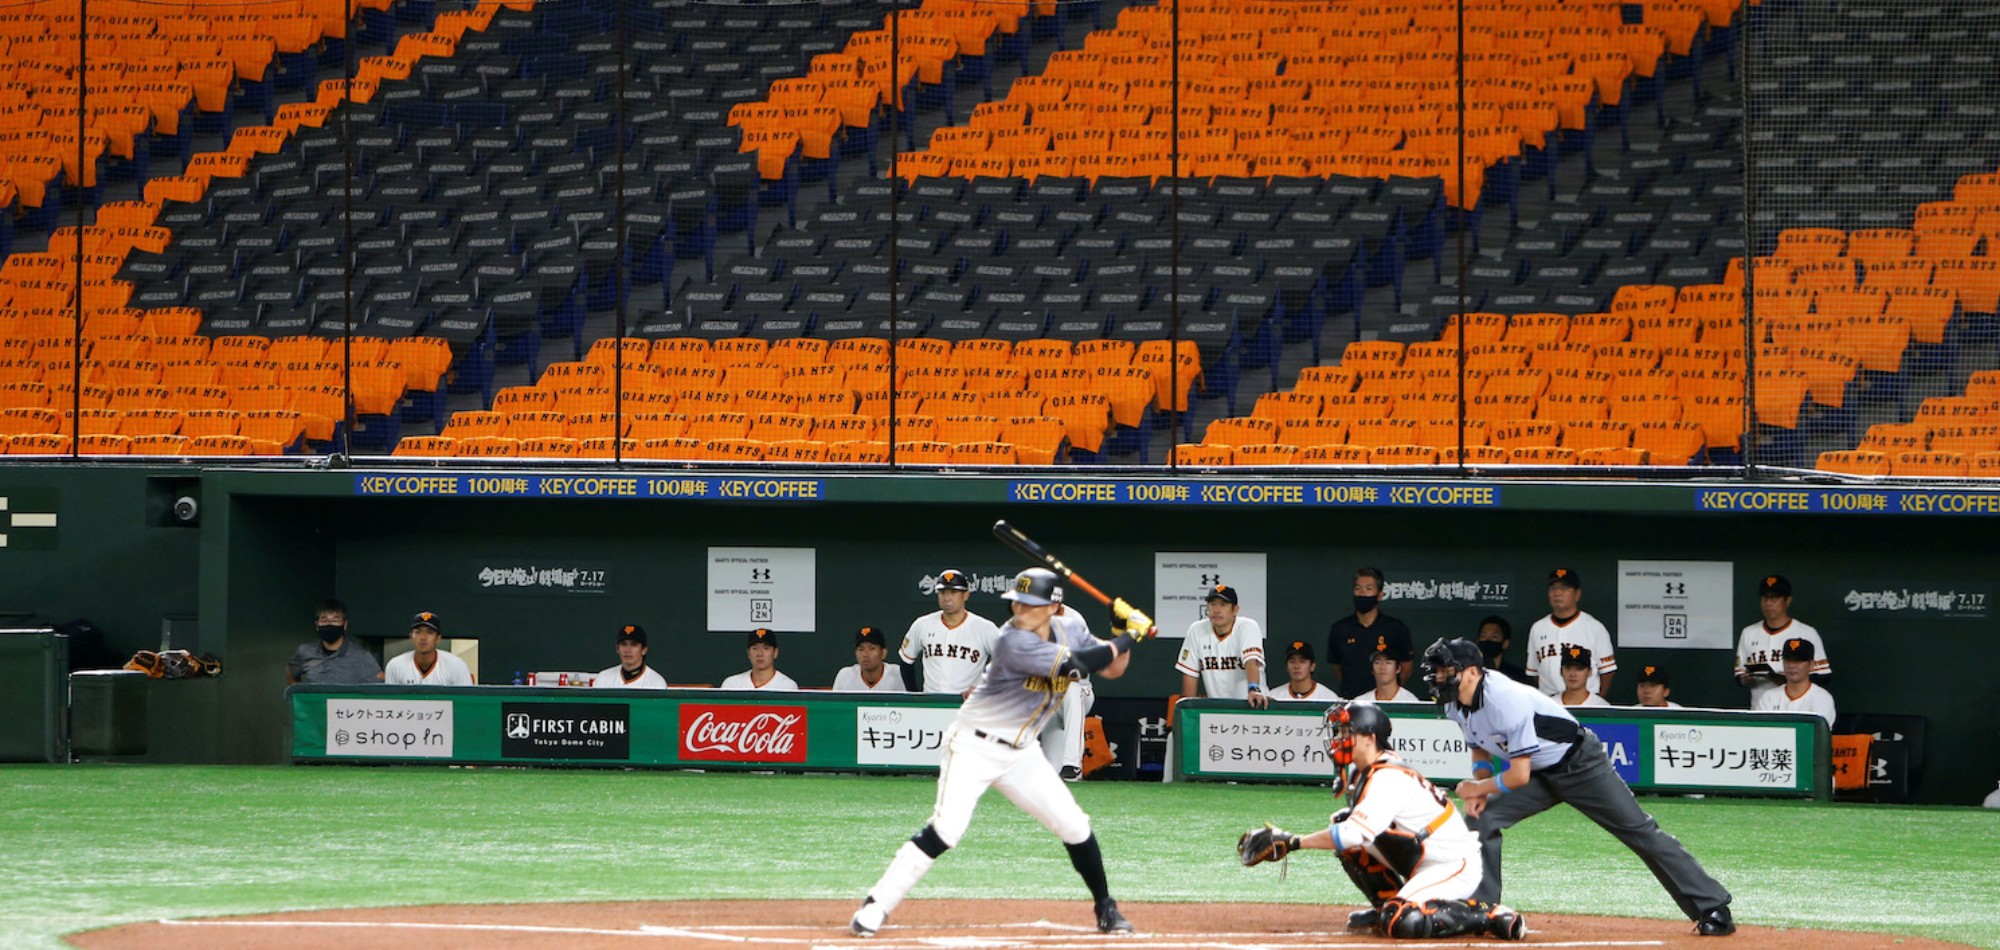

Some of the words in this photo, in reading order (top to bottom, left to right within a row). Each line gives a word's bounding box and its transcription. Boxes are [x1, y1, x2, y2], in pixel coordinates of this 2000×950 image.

[409, 33, 452, 45] GIANTS
[280, 108, 329, 120] GIANTS
[733, 109, 779, 118] GIANTS
[974, 105, 1019, 117] GIANTS
[236, 127, 282, 139] GIANTS
[748, 131, 794, 142] GIANTS
[935, 130, 984, 142] GIANTS
[997, 127, 1047, 138] GIANTS
[194, 156, 242, 166] GIANTS
[956, 158, 1003, 170] GIANTS
[1019, 156, 1067, 168] GIANTS
[1680, 291, 1734, 302] GIANTS
[1511, 318, 1563, 327] GIANTS
[1639, 318, 1692, 329] GIANTS
[155, 336, 211, 346] GIANTS
[222, 338, 269, 350] GIANTS
[654, 341, 704, 351] GIANTS
[1074, 340, 1126, 356] GIANTS
[1410, 348, 1459, 358] GIANTS
[1472, 346, 1526, 355] GIANTS
[1601, 347, 1654, 360] GIANTS
[1665, 348, 1719, 360] GIANTS
[109, 359, 158, 370] GIANTS
[548, 366, 600, 376] GIANTS
[665, 367, 716, 378] GIANTS
[1035, 369, 1086, 379] GIANTS
[1098, 368, 1150, 380] GIANTS
[1556, 369, 1610, 381] GIANTS
[1682, 370, 1737, 380] GIANTS
[118, 388, 170, 398] GIANTS
[497, 392, 548, 404] GIANTS
[622, 392, 670, 403] GIANTS
[745, 390, 794, 404] GIANTS
[1053, 395, 1106, 406] GIANTS
[1332, 396, 1389, 404] GIANTS
[1474, 394, 1530, 405] GIANTS
[4, 409, 55, 422] GIANTS
[449, 415, 500, 427] GIANTS
[513, 413, 565, 423] GIANTS
[1498, 426, 1552, 440] GIANTS
[12, 437, 60, 448] GIANTS
[194, 438, 247, 449] GIANTS
[401, 440, 452, 450] GIANTS
[523, 442, 572, 453] GIANTS
[645, 439, 699, 448] GIANTS
[707, 441, 759, 456] GIANTS
[1377, 447, 1430, 456] GIANTS
[1513, 449, 1573, 459] GIANTS
[1305, 450, 1360, 460] GIANTS
[468, 478, 529, 494] 100周年
[647, 479, 709, 496] 100周年
[1126, 484, 1190, 501] 100周年
[1314, 486, 1379, 503] 100周年
[1820, 493, 1888, 511] 100周年
[1900, 494, 2000, 513] KEYCOFFE
[580, 571, 605, 580] 7.17
[1482, 584, 1508, 594] 7.17
[1958, 594, 1986, 604] 7.17
[335, 708, 444, 720] セレクトコスメショップ
[862, 712, 888, 723] Kyorin
[532, 719, 574, 734] FIRST
[580, 720, 625, 735] CABIN
[686, 712, 802, 754] Coca-Cola
[1659, 729, 1686, 741] Kyorin
[356, 730, 416, 750] shop
[534, 738, 559, 747] Tokyo
[562, 739, 584, 747] Dome
[586, 738, 605, 748] City
[1392, 738, 1426, 752] IRST
[1433, 739, 1468, 752] CABI
[1231, 745, 1296, 767] shop
[1660, 745, 1793, 770] キョーリン製薬
[1758, 772, 1793, 782] グループ
